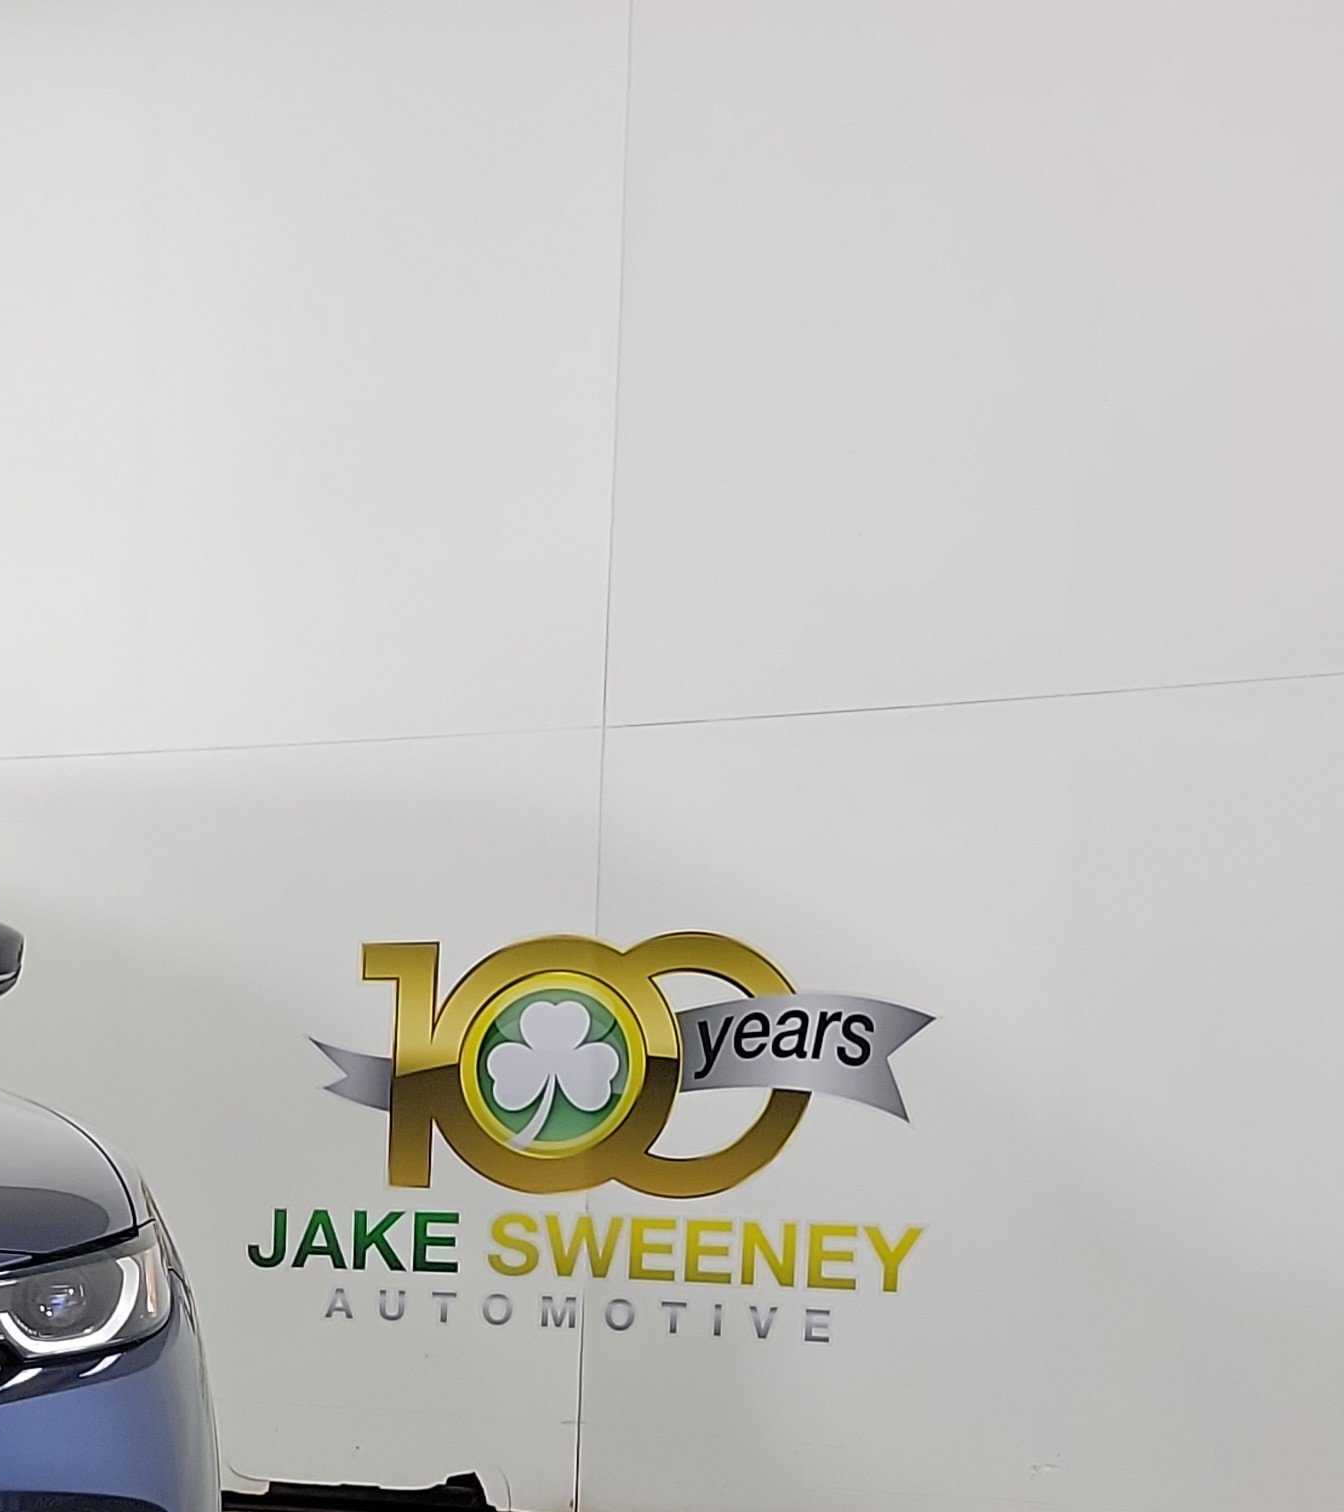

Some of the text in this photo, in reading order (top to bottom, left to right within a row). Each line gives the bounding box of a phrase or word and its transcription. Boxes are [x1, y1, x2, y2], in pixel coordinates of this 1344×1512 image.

[361, 931, 875, 1199] 100 years
[247, 1207, 923, 1293] JAKE SWEENEY
[324, 1288, 832, 1343] AUTOMOTIVE
